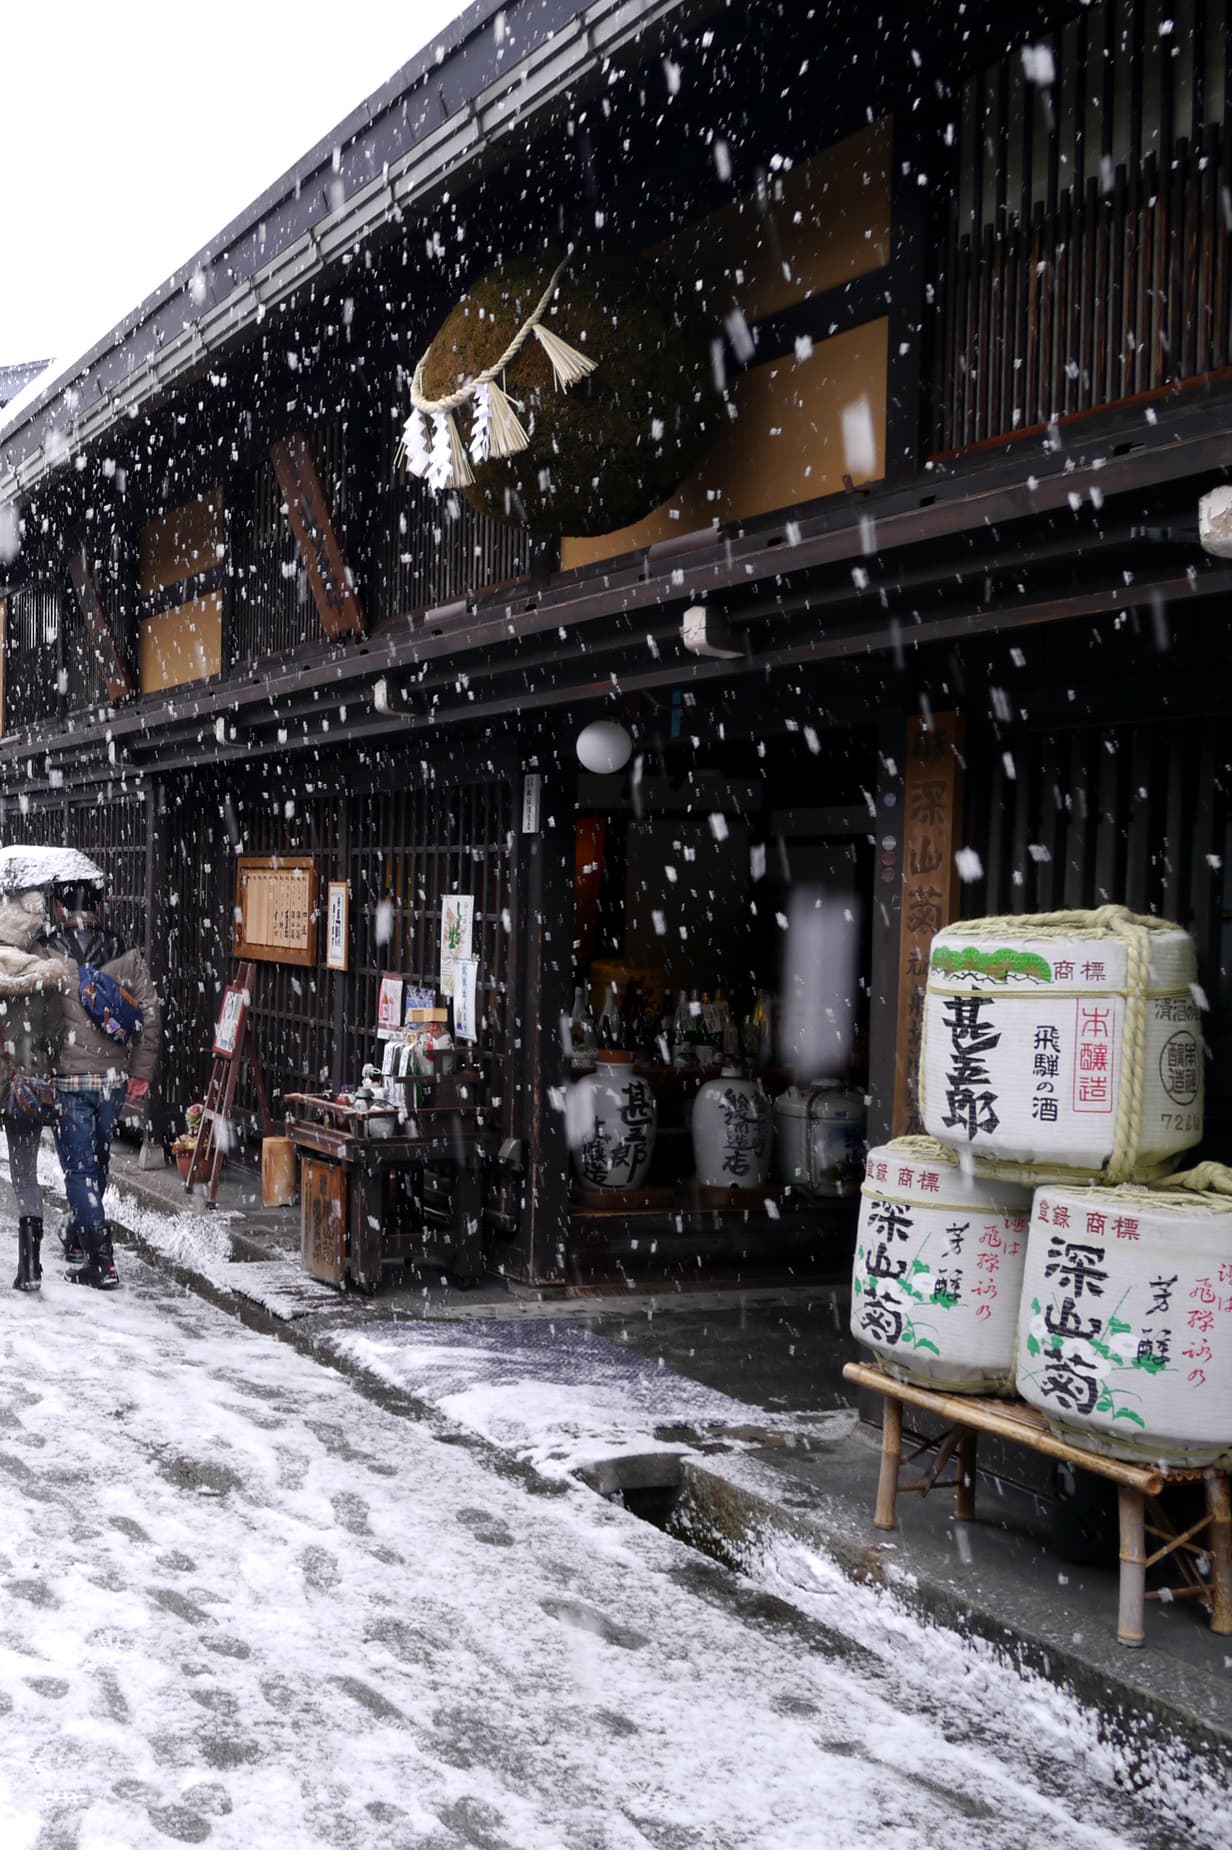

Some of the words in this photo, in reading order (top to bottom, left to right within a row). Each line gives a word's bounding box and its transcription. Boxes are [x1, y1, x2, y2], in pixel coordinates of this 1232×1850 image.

[1053, 960, 1106, 981] 商標
[941, 985, 1002, 1142] 甚五郎
[1032, 1025, 1061, 1122] 飛騨の酒
[1079, 1007, 1110, 1102] 本醸造
[861, 1190, 915, 1345] 深山菊
[1041, 1236, 1110, 1414] 深山菊
